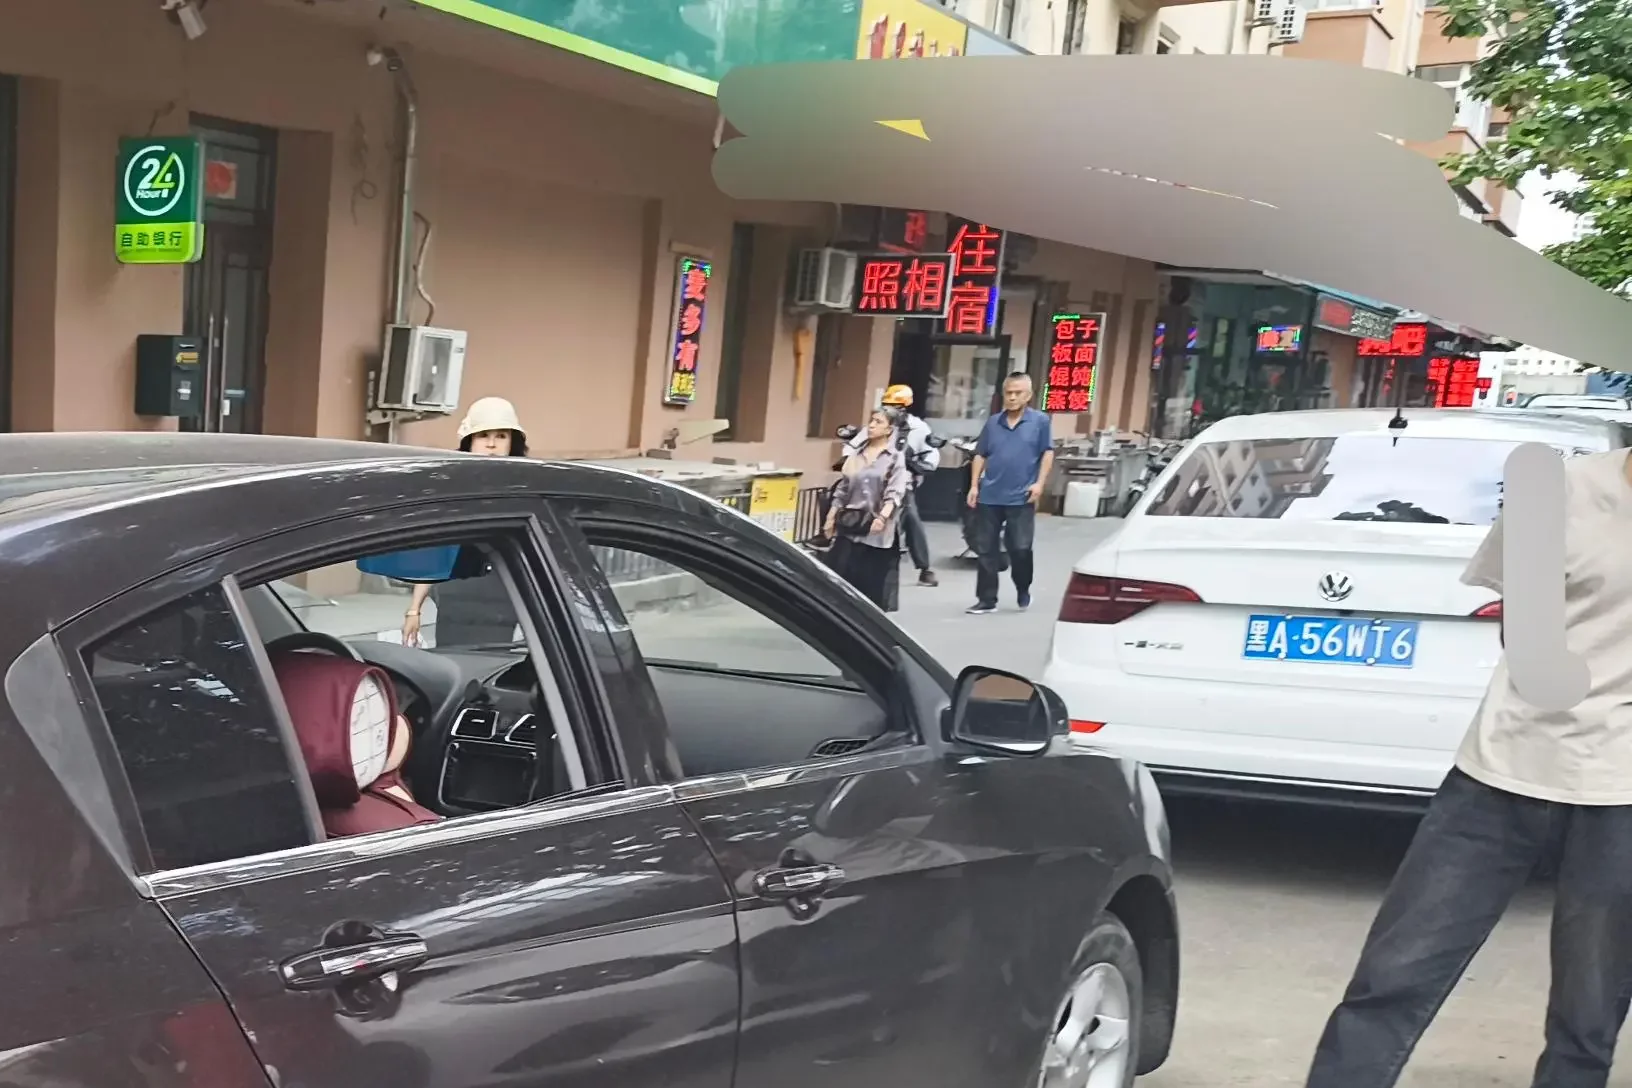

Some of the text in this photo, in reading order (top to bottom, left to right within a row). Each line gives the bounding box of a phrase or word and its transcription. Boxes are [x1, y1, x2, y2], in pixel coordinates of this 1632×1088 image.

[137, 154, 176, 193] 24
[121, 231, 182, 247] 自助银行
[858, 257, 946, 312] 照相
[945, 223, 1000, 334] 住宿
[1055, 319, 1099, 339] 包子
[1052, 342, 1097, 364] 板面
